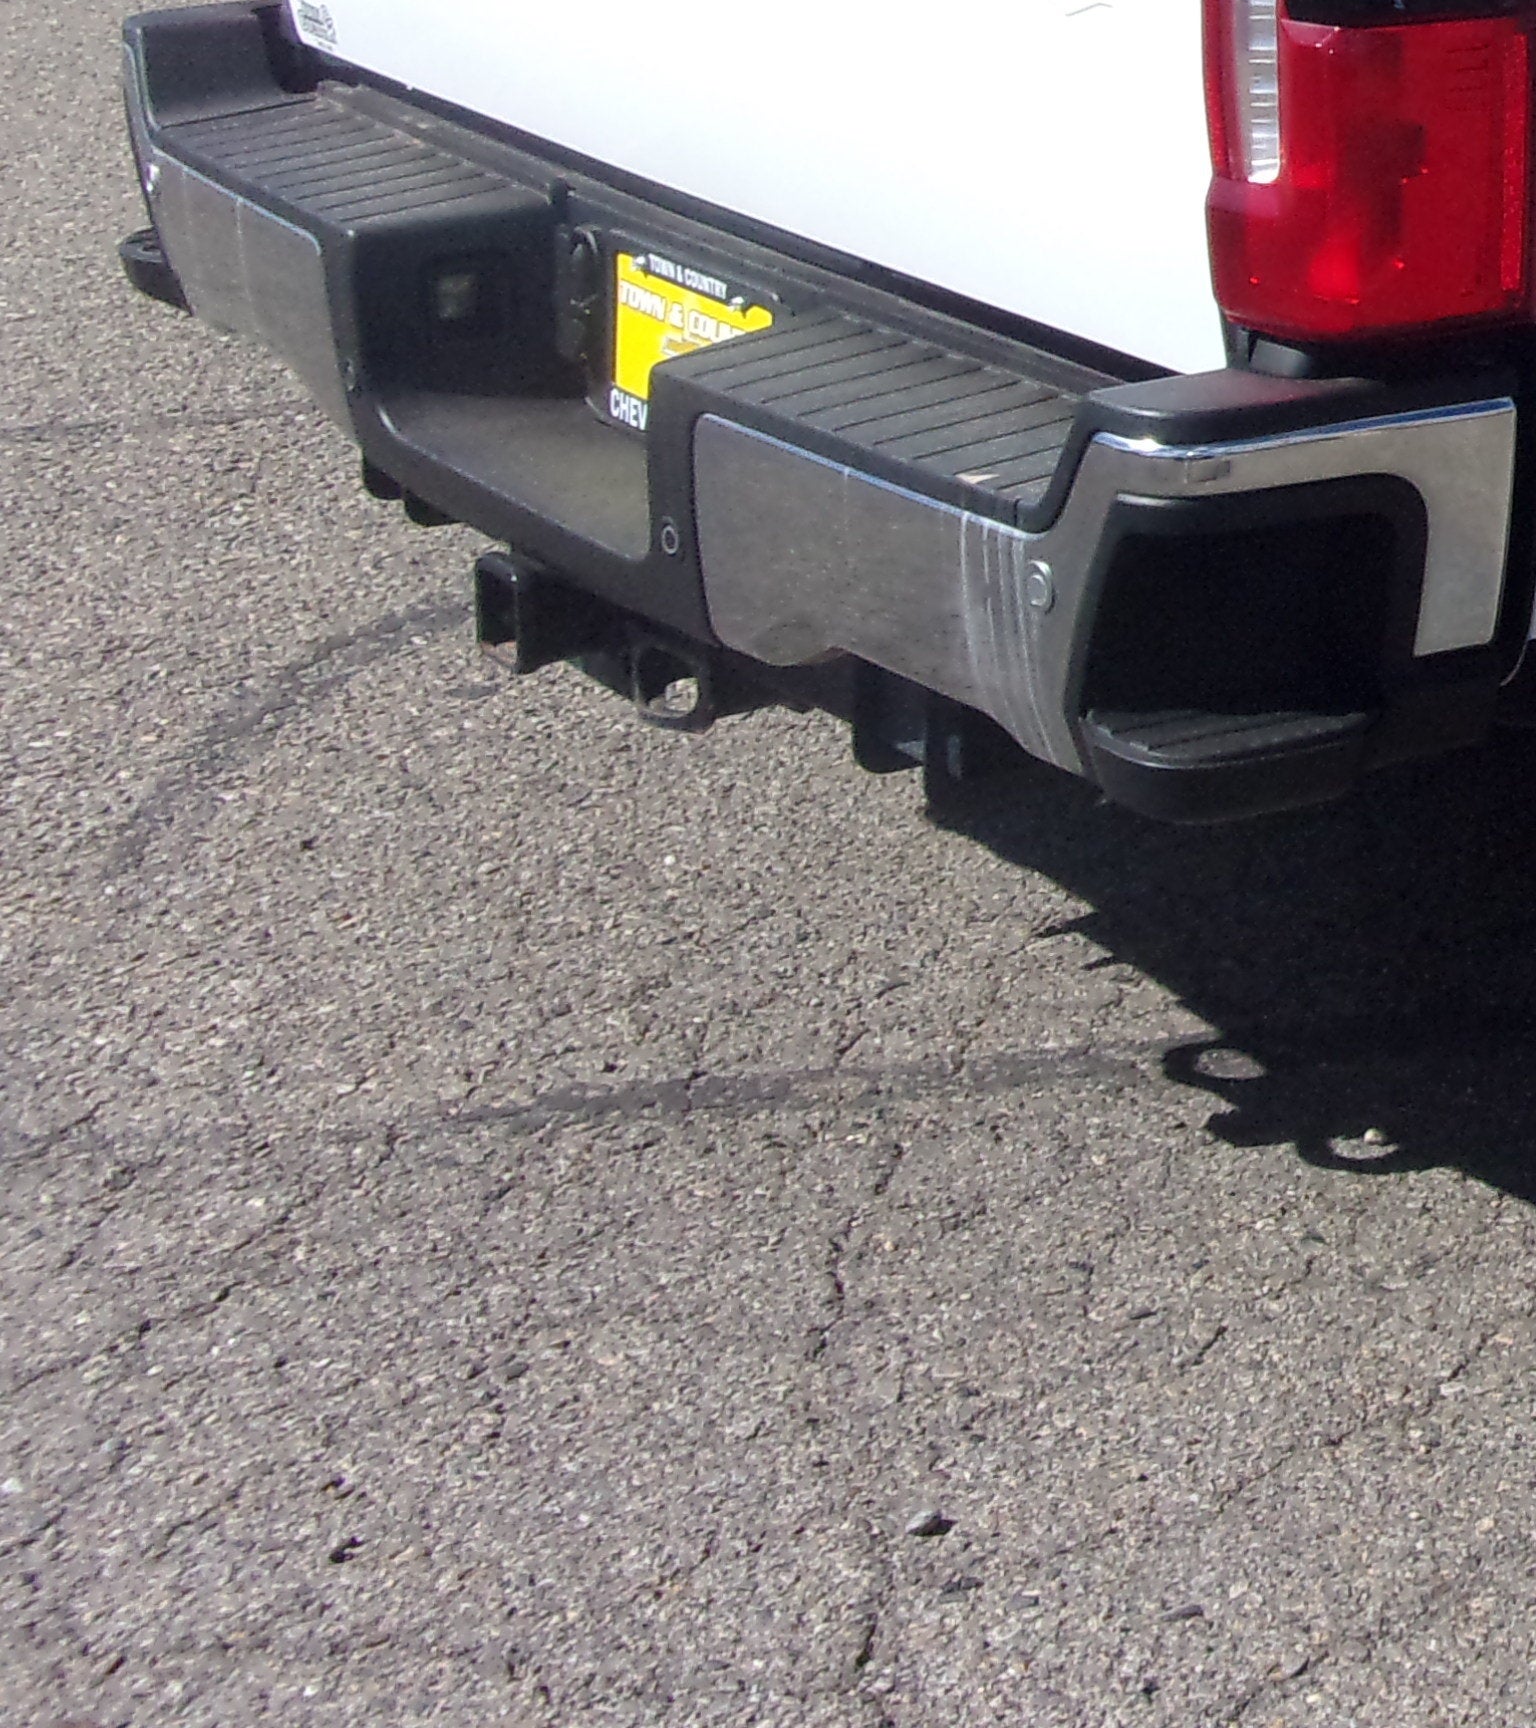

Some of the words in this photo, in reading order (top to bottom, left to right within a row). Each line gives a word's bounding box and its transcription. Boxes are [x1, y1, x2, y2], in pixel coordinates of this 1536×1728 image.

[648, 253, 676, 279] TOWN
[684, 268, 727, 300] COUNTRY
[619, 279, 666, 322] TOWN
[669, 301, 685, 329] &
